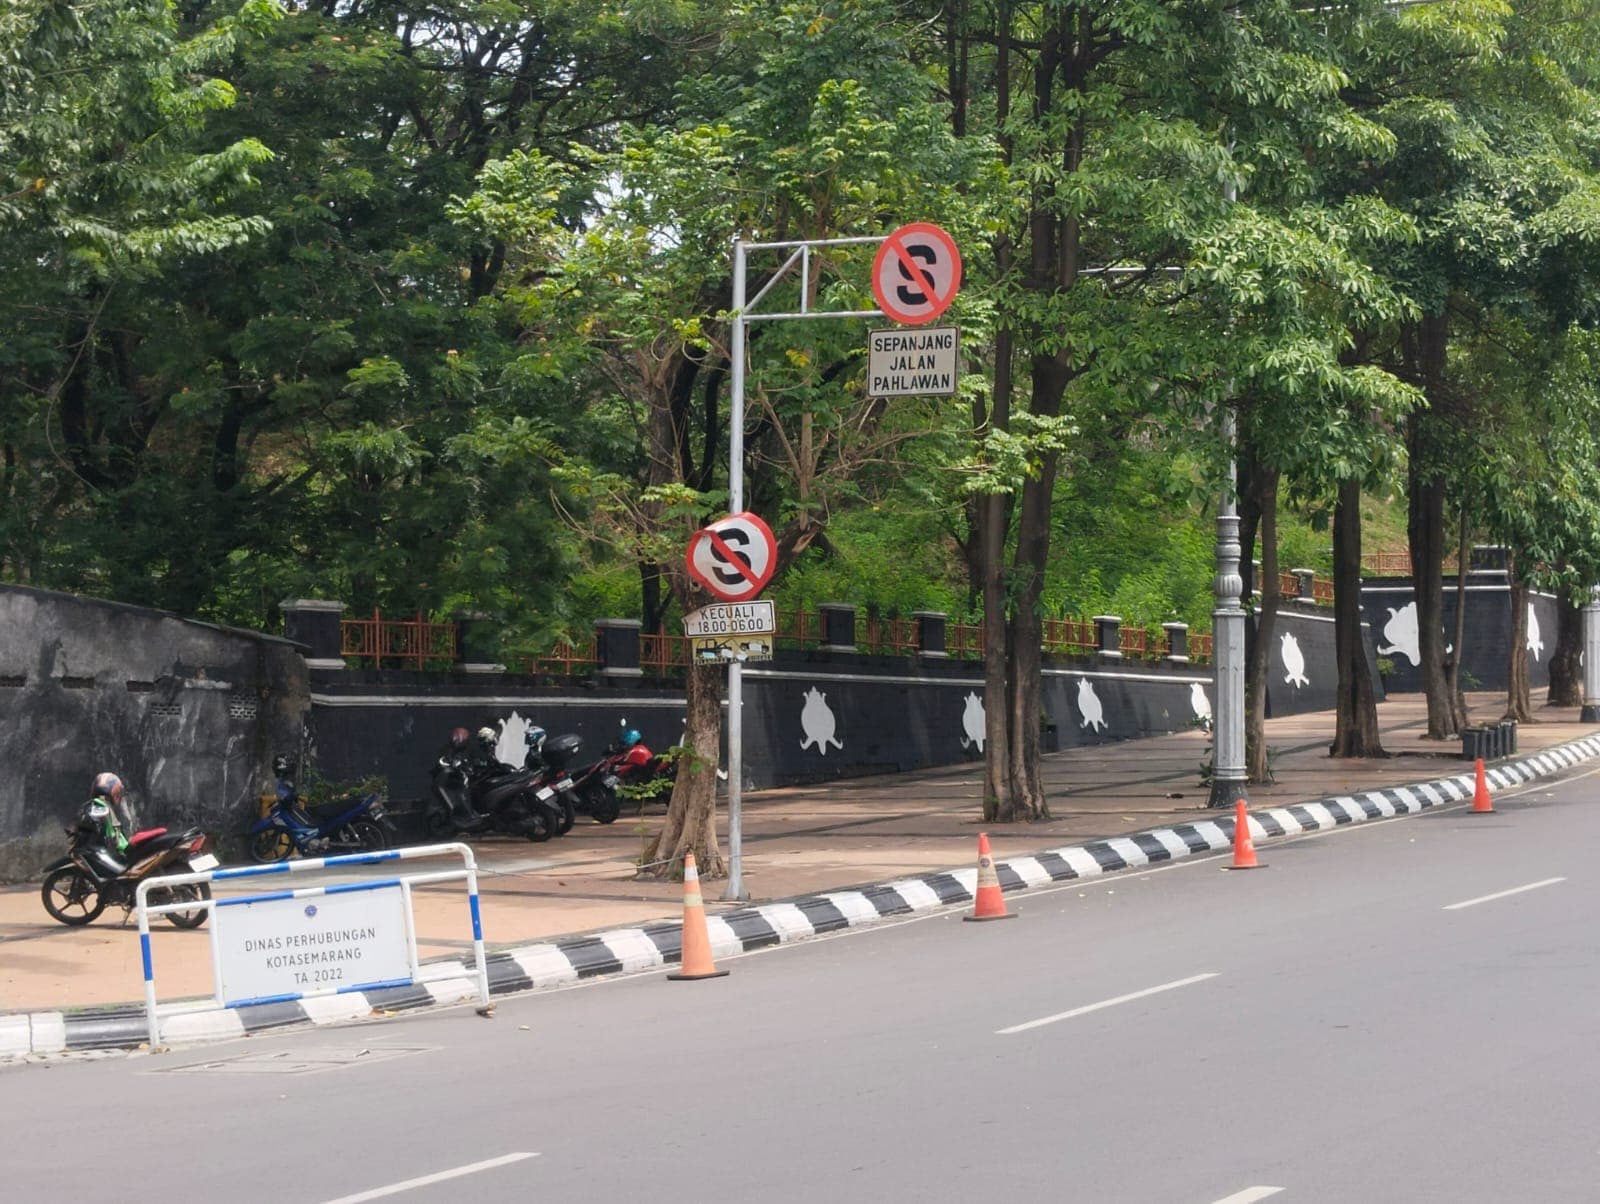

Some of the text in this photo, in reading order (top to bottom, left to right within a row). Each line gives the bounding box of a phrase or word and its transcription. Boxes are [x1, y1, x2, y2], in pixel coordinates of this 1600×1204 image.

[874, 334, 953, 352] SEPANJANG
[889, 354, 936, 371] JALAN
[873, 373, 950, 392] PAHLAWAN
[701, 605, 754, 620] KECUALI
[698, 618, 764, 633] 18.00-06.00
[245, 927, 376, 952] DINAS PERHUBUNGAN
[294, 967, 343, 985] TA 2022
